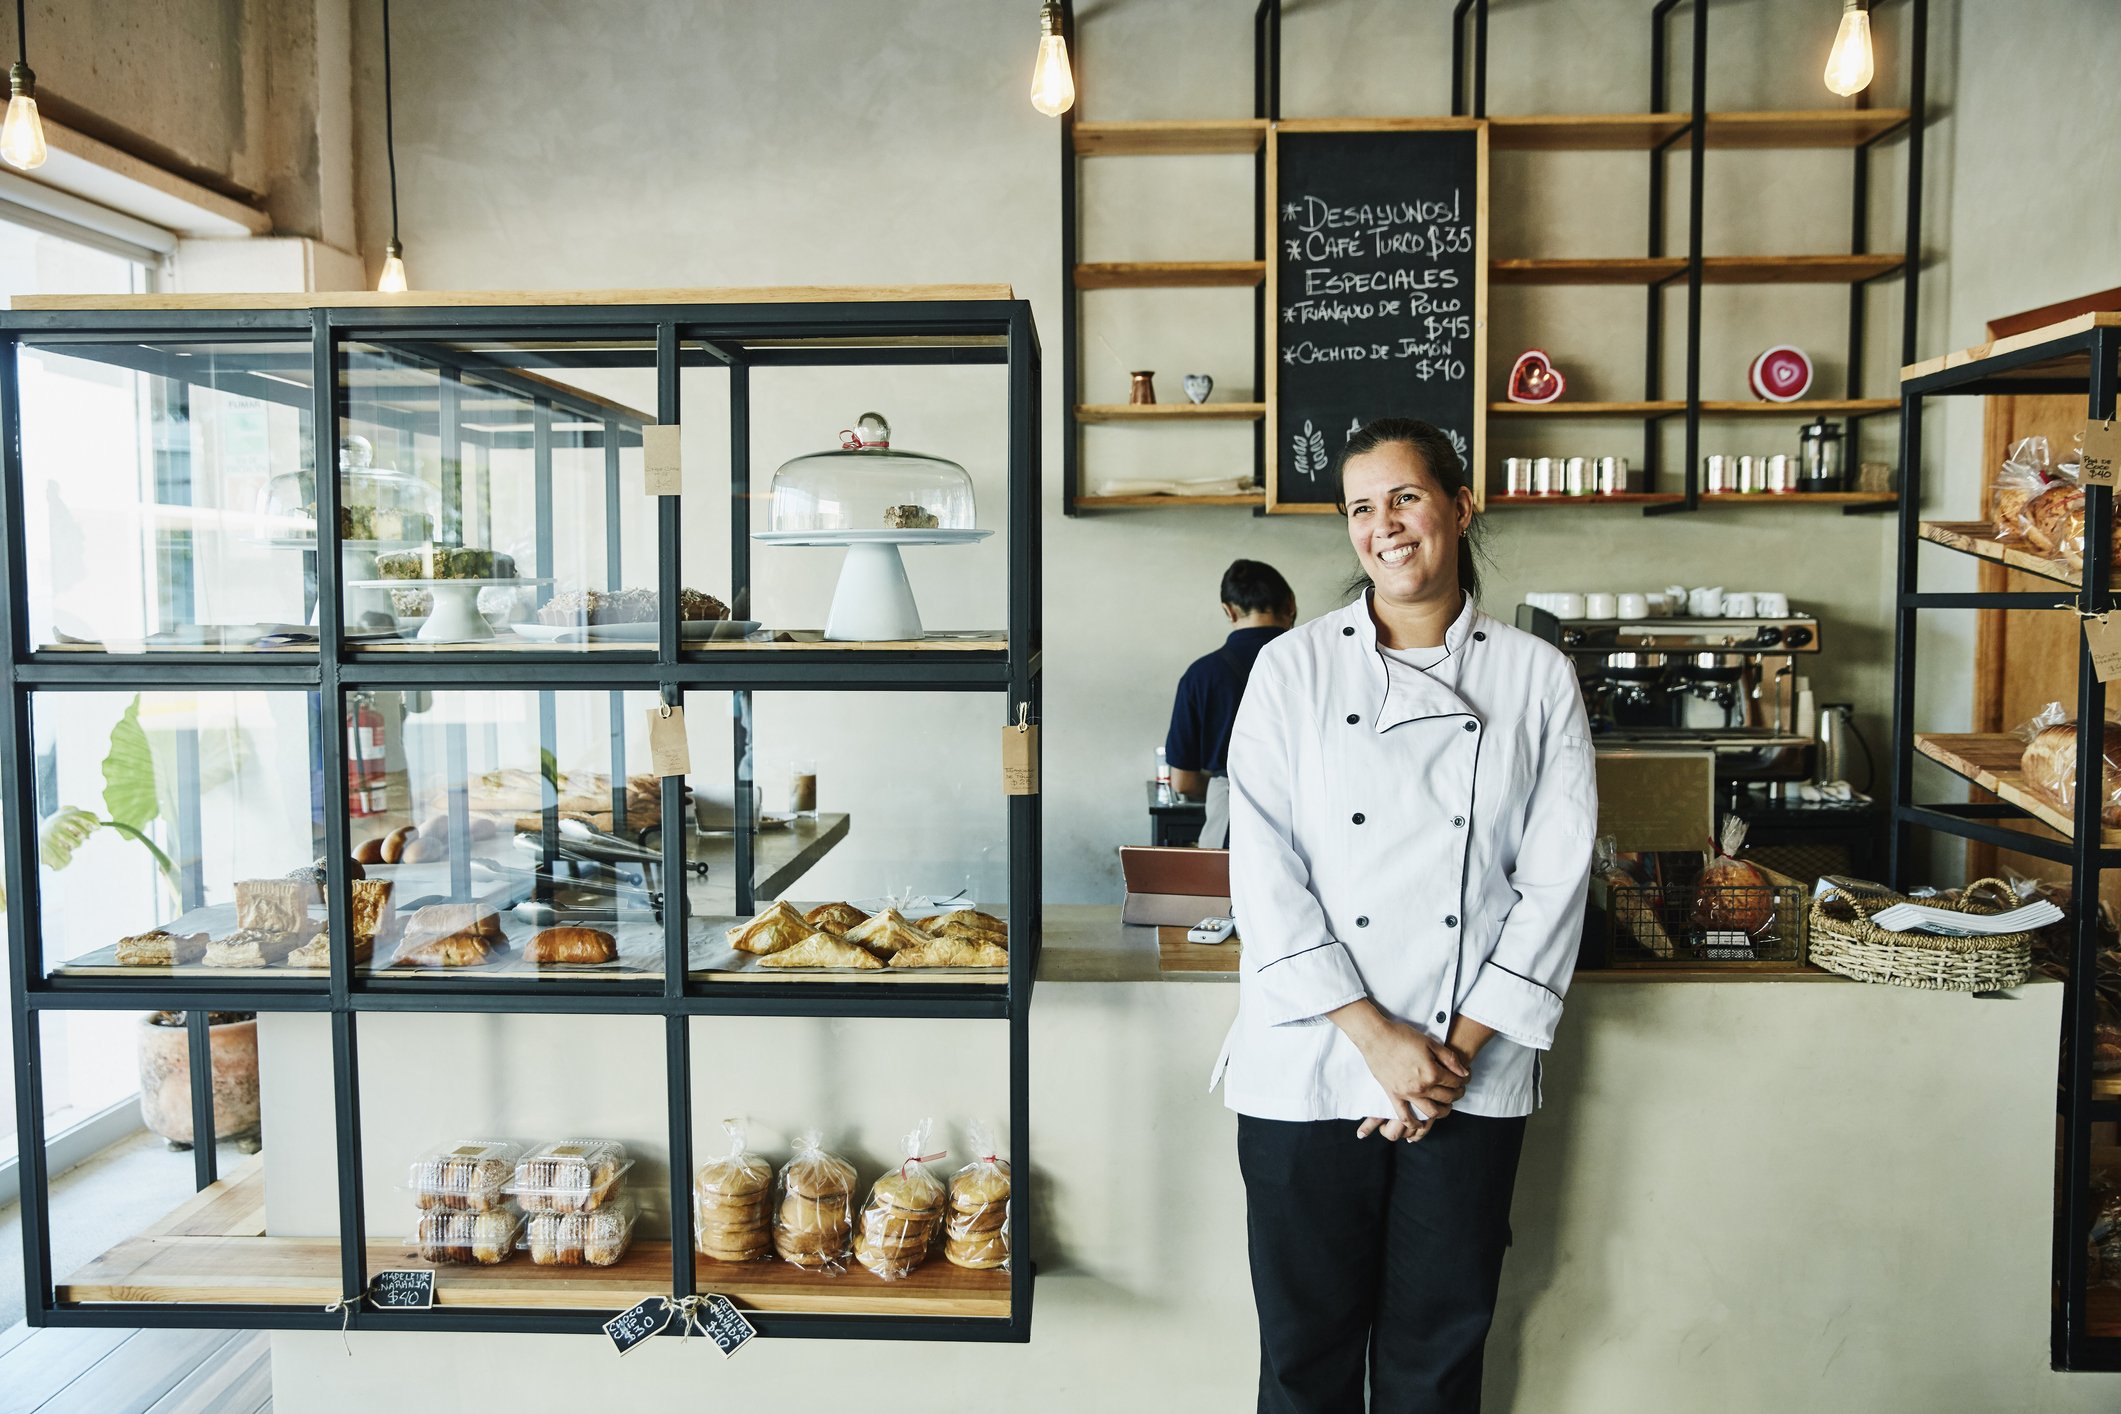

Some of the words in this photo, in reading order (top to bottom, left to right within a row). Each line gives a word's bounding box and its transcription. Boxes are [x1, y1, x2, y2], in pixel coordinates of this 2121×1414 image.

[1299, 188, 1460, 232] DESAYUNOS!
[1306, 230, 1364, 261] CAFÉ
[1366, 226, 1424, 258] TURCO
[1426, 225, 1472, 261] $35
[1306, 268, 1459, 296] ESPECIALES
[1378, 301, 1400, 317] DE
[1409, 291, 1461, 316] POLLO
[1424, 316, 1470, 340] $45
[1297, 341, 1366, 364] CACHITO
[1370, 344, 1390, 360] DE
[1416, 358, 1465, 381] $40
[380, 1280, 430, 1291] NARANJA
[382, 1271, 430, 1282] MADELEINE
[387, 1290, 419, 1306] $40
[609, 1306, 644, 1332] CHOCO
[706, 1320, 731, 1348] $40
